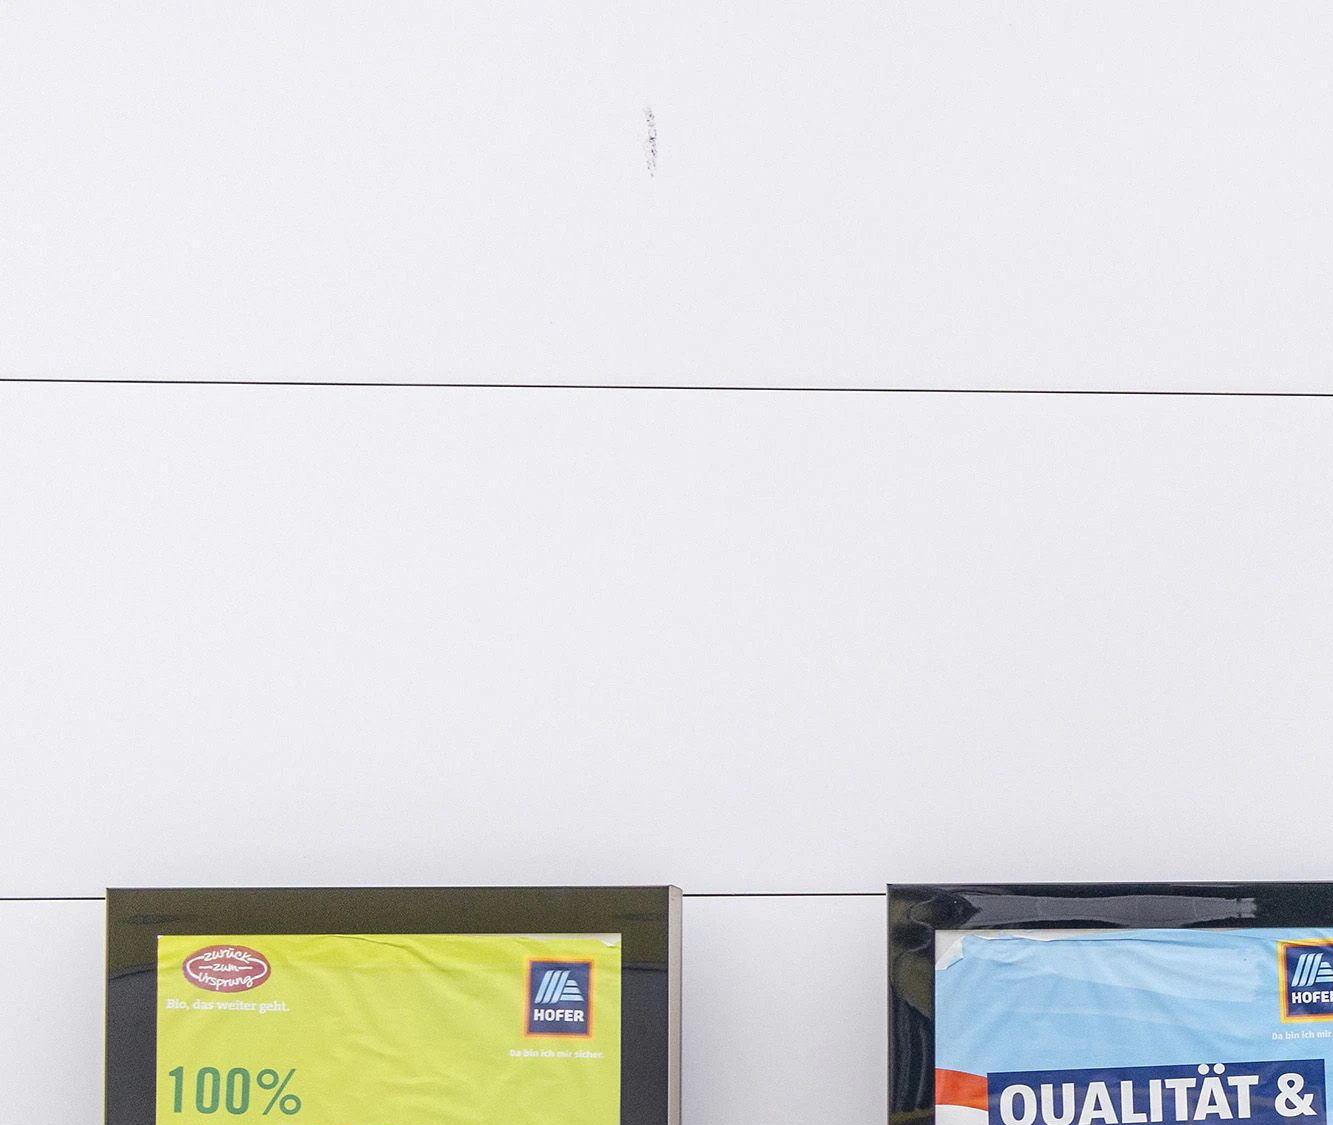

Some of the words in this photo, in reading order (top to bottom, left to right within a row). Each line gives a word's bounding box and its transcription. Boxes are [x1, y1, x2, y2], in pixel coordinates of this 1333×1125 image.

[203, 947, 251, 963] zurück
[212, 963, 239, 972] zum
[198, 972, 254, 990] Ursprung
[166, 999, 190, 1011] Bio,
[192, 1000, 213, 1010] das
[217, 1000, 256, 1011] weiter
[256, 1000, 290, 1014] geht.
[533, 1008, 584, 1022] HOFER
[1272, 1032, 1283, 1040] Da
[1285, 1031, 1300, 1040] bin
[1301, 1030, 1315, 1039] ich
[1317, 1030, 1332, 1038] mir
[168, 1065, 302, 1116] 100%
[1274, 1072, 1317, 1118] &
